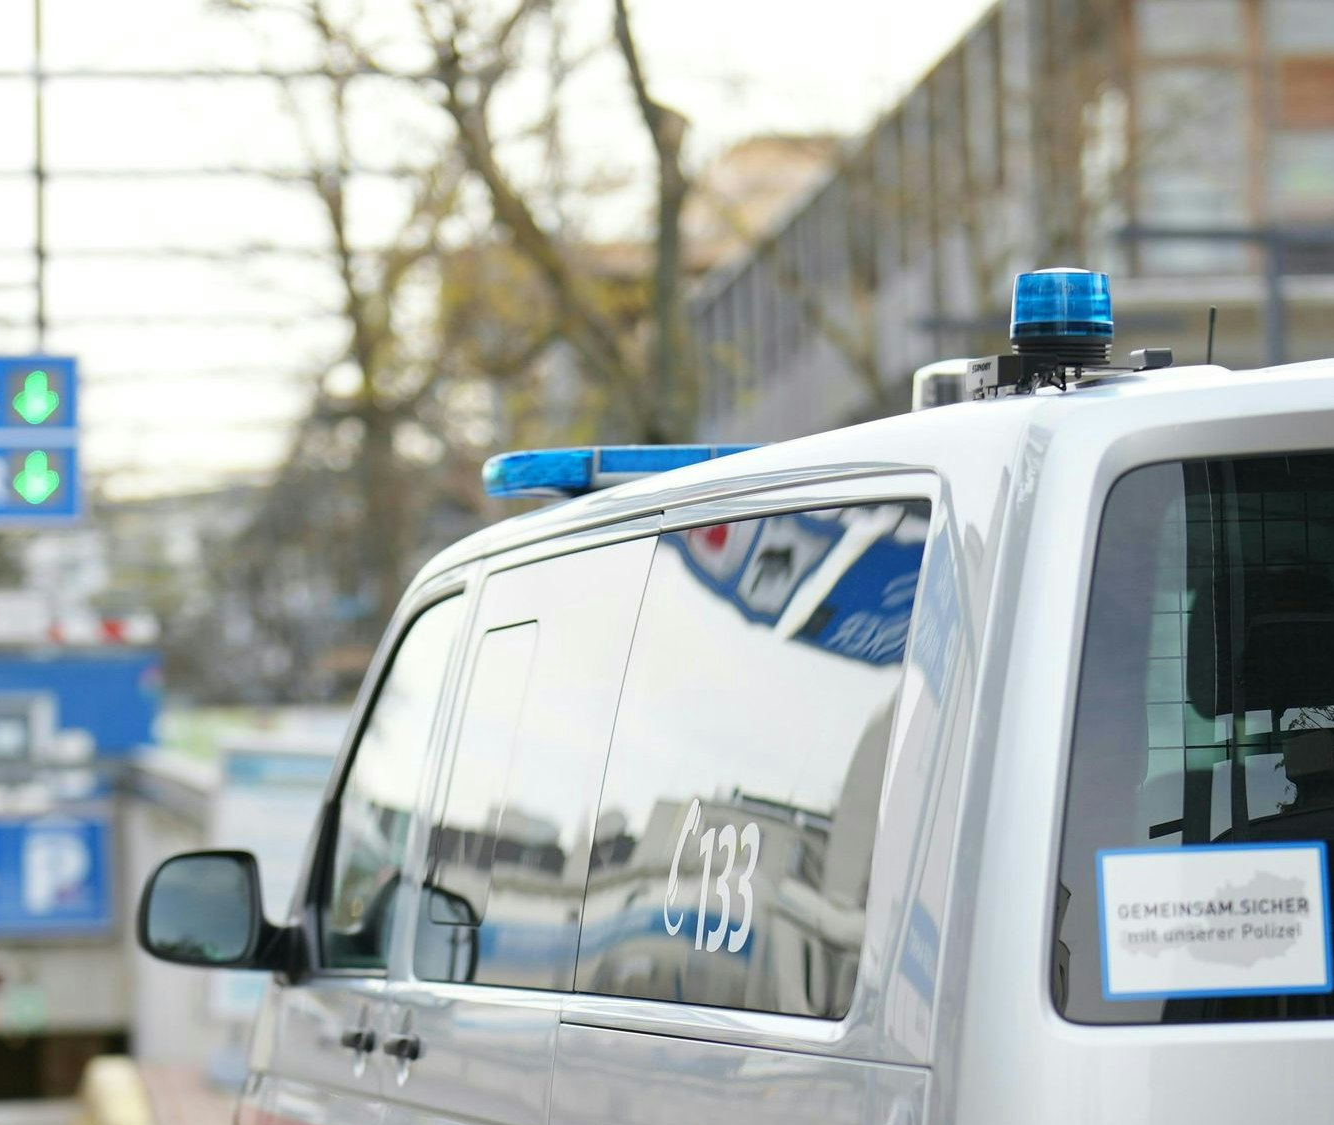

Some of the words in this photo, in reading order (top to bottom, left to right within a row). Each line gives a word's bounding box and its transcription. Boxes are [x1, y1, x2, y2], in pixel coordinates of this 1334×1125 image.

[695, 822, 761, 953] 133
[1126, 928, 1158, 944] mit
[1163, 926, 1235, 943] unserer
[1241, 922, 1302, 939] Polizei
